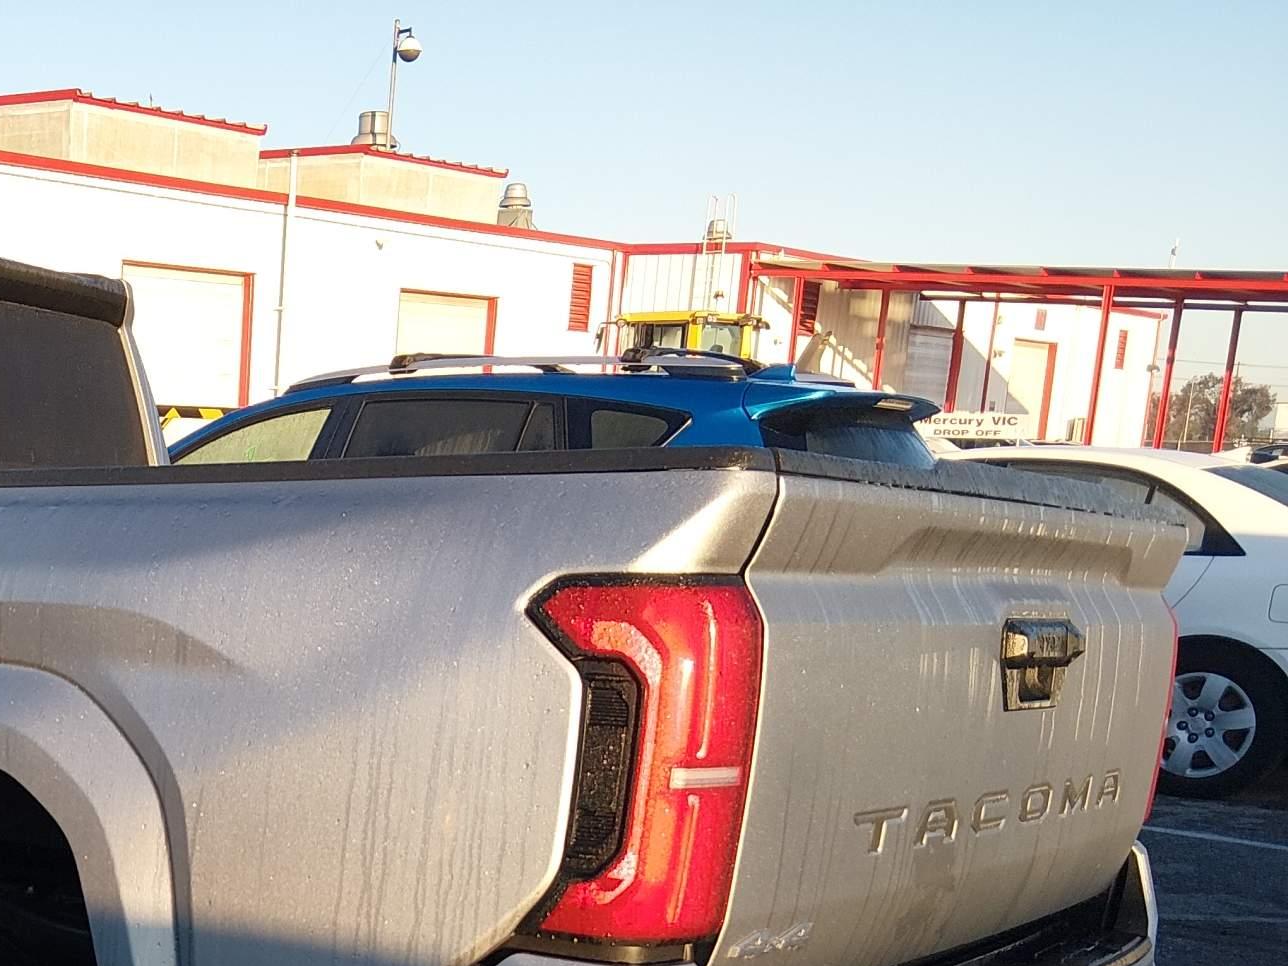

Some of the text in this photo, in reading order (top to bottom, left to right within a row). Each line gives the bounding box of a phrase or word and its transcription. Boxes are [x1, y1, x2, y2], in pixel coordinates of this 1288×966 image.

[919, 416, 1018, 427] Mercury VIC
[853, 768, 1120, 855] TACOMA
